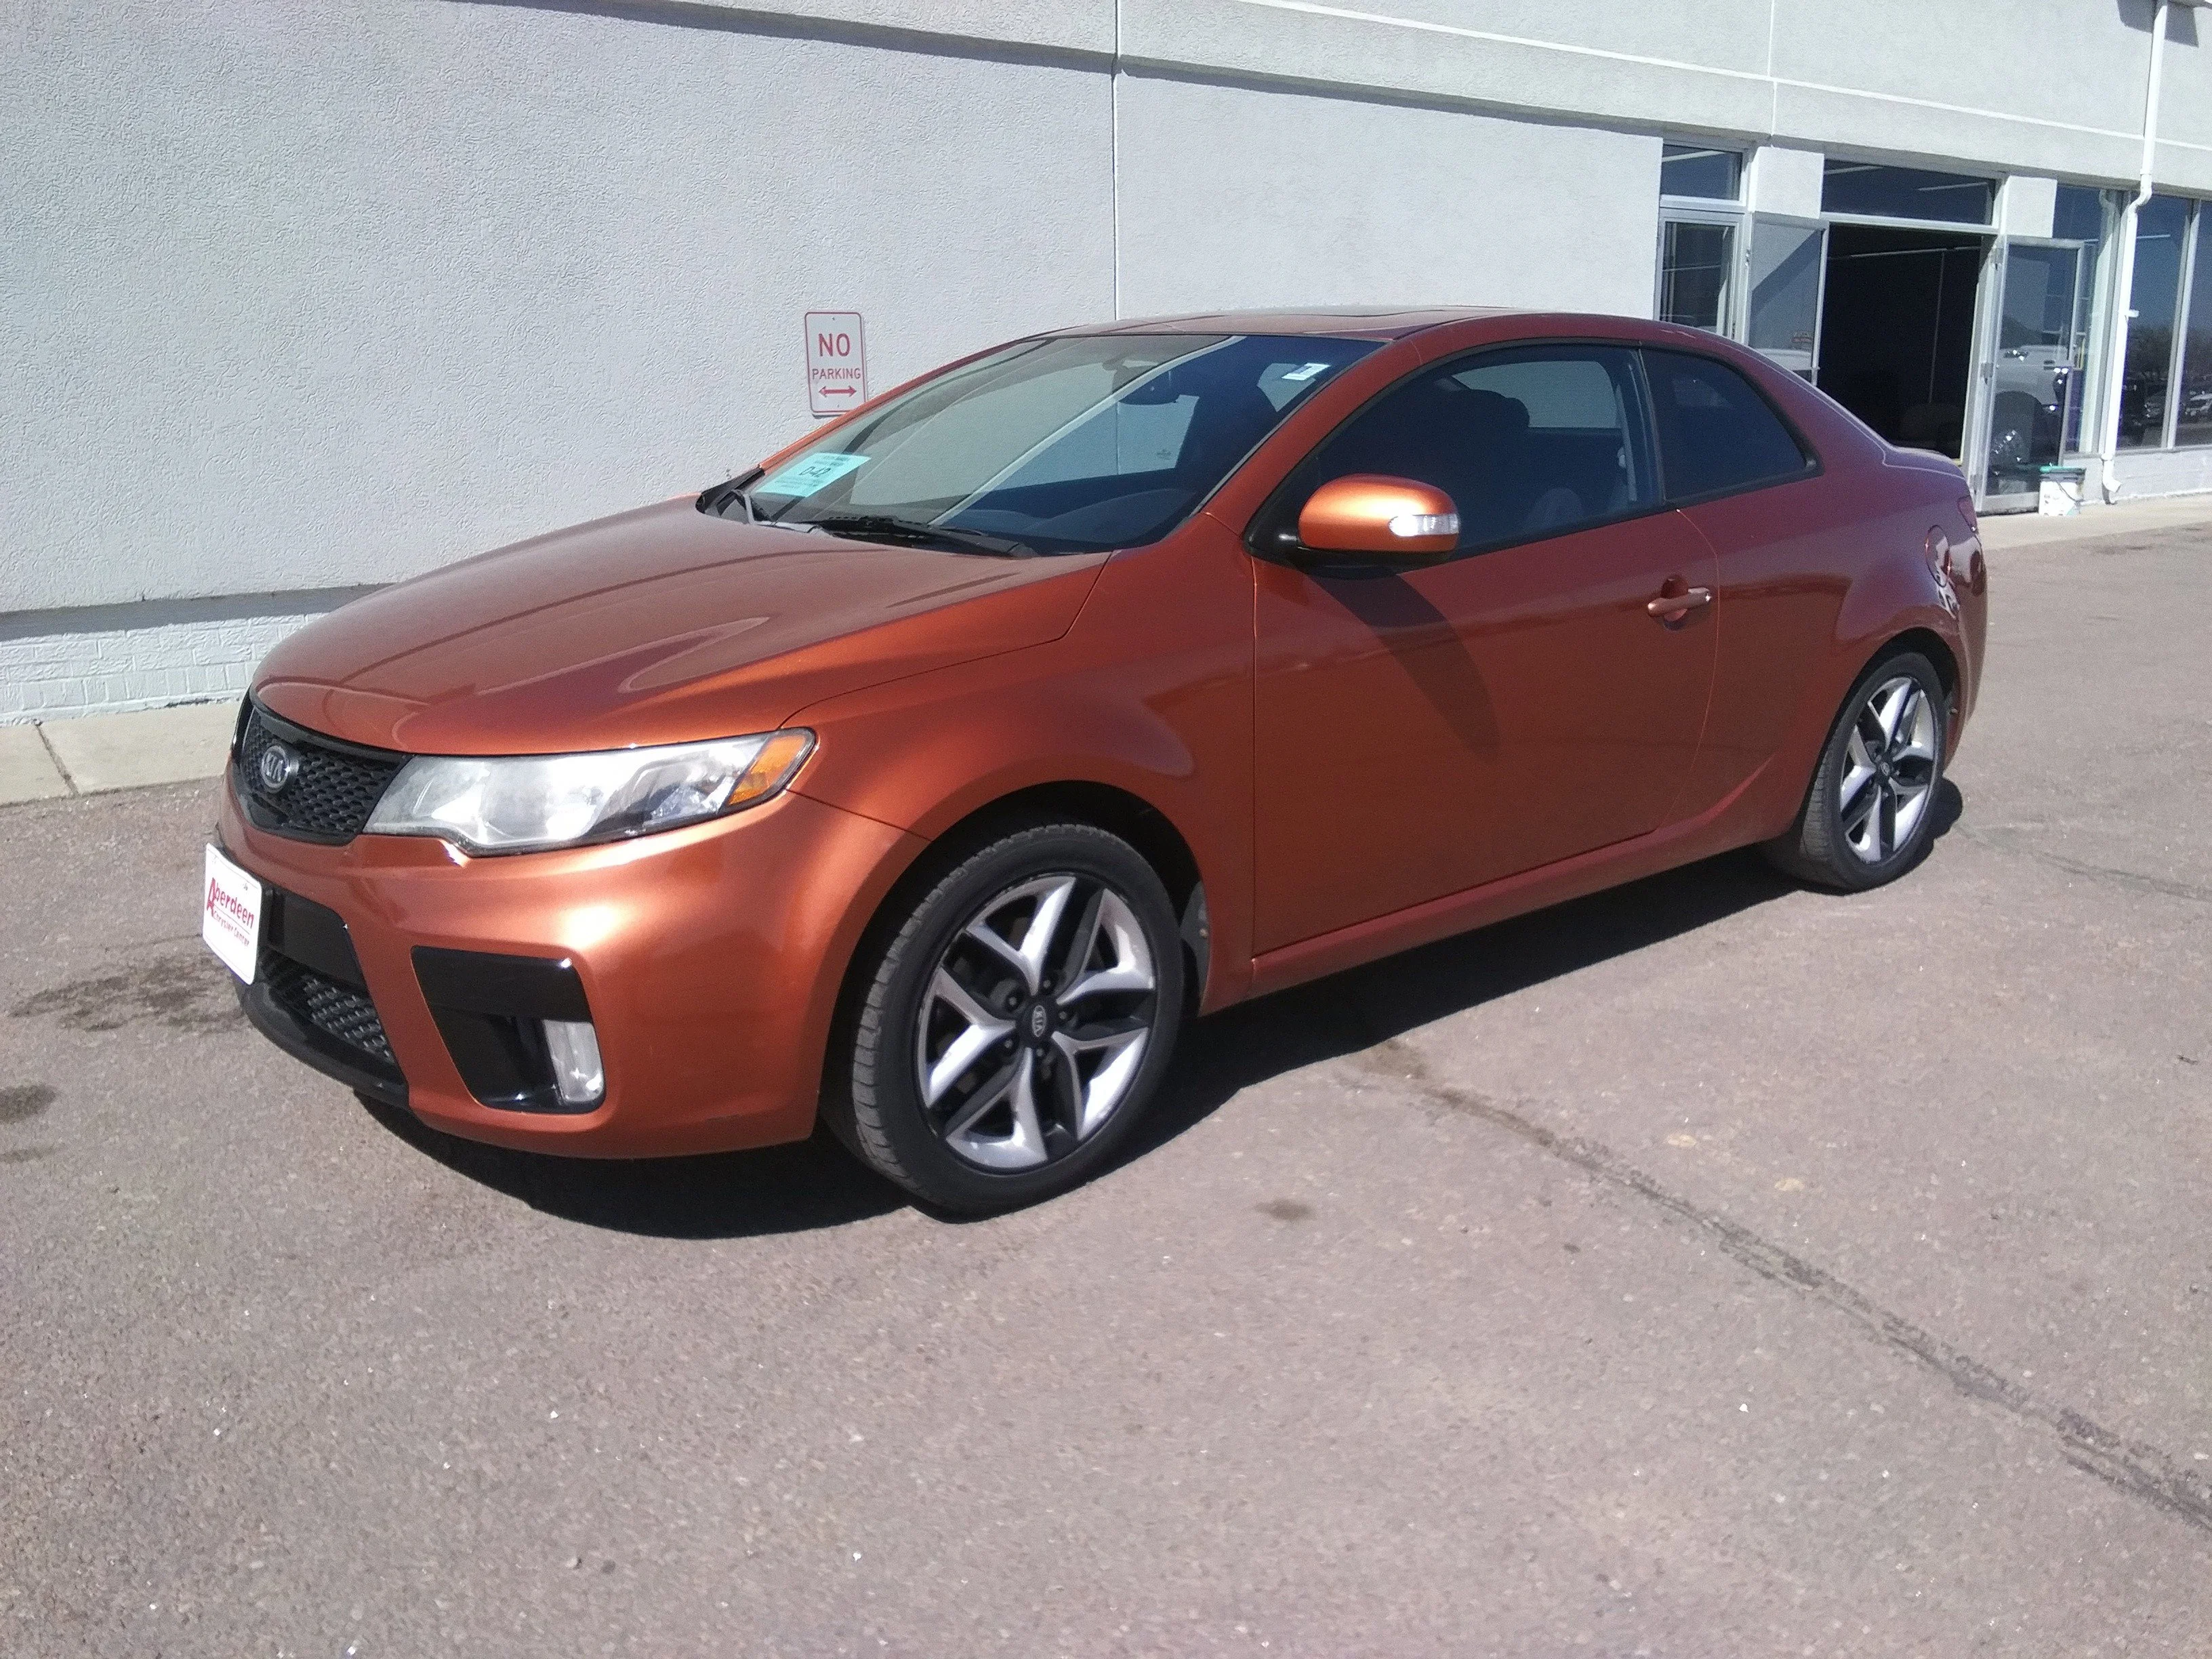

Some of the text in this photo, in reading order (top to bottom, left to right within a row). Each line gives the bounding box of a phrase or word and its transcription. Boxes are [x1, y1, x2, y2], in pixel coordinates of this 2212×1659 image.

[819, 333, 851, 357] NO
[812, 368, 861, 380] PARKING
[265, 752, 284, 782] KIA
[207, 877, 254, 929] Aberdeen
